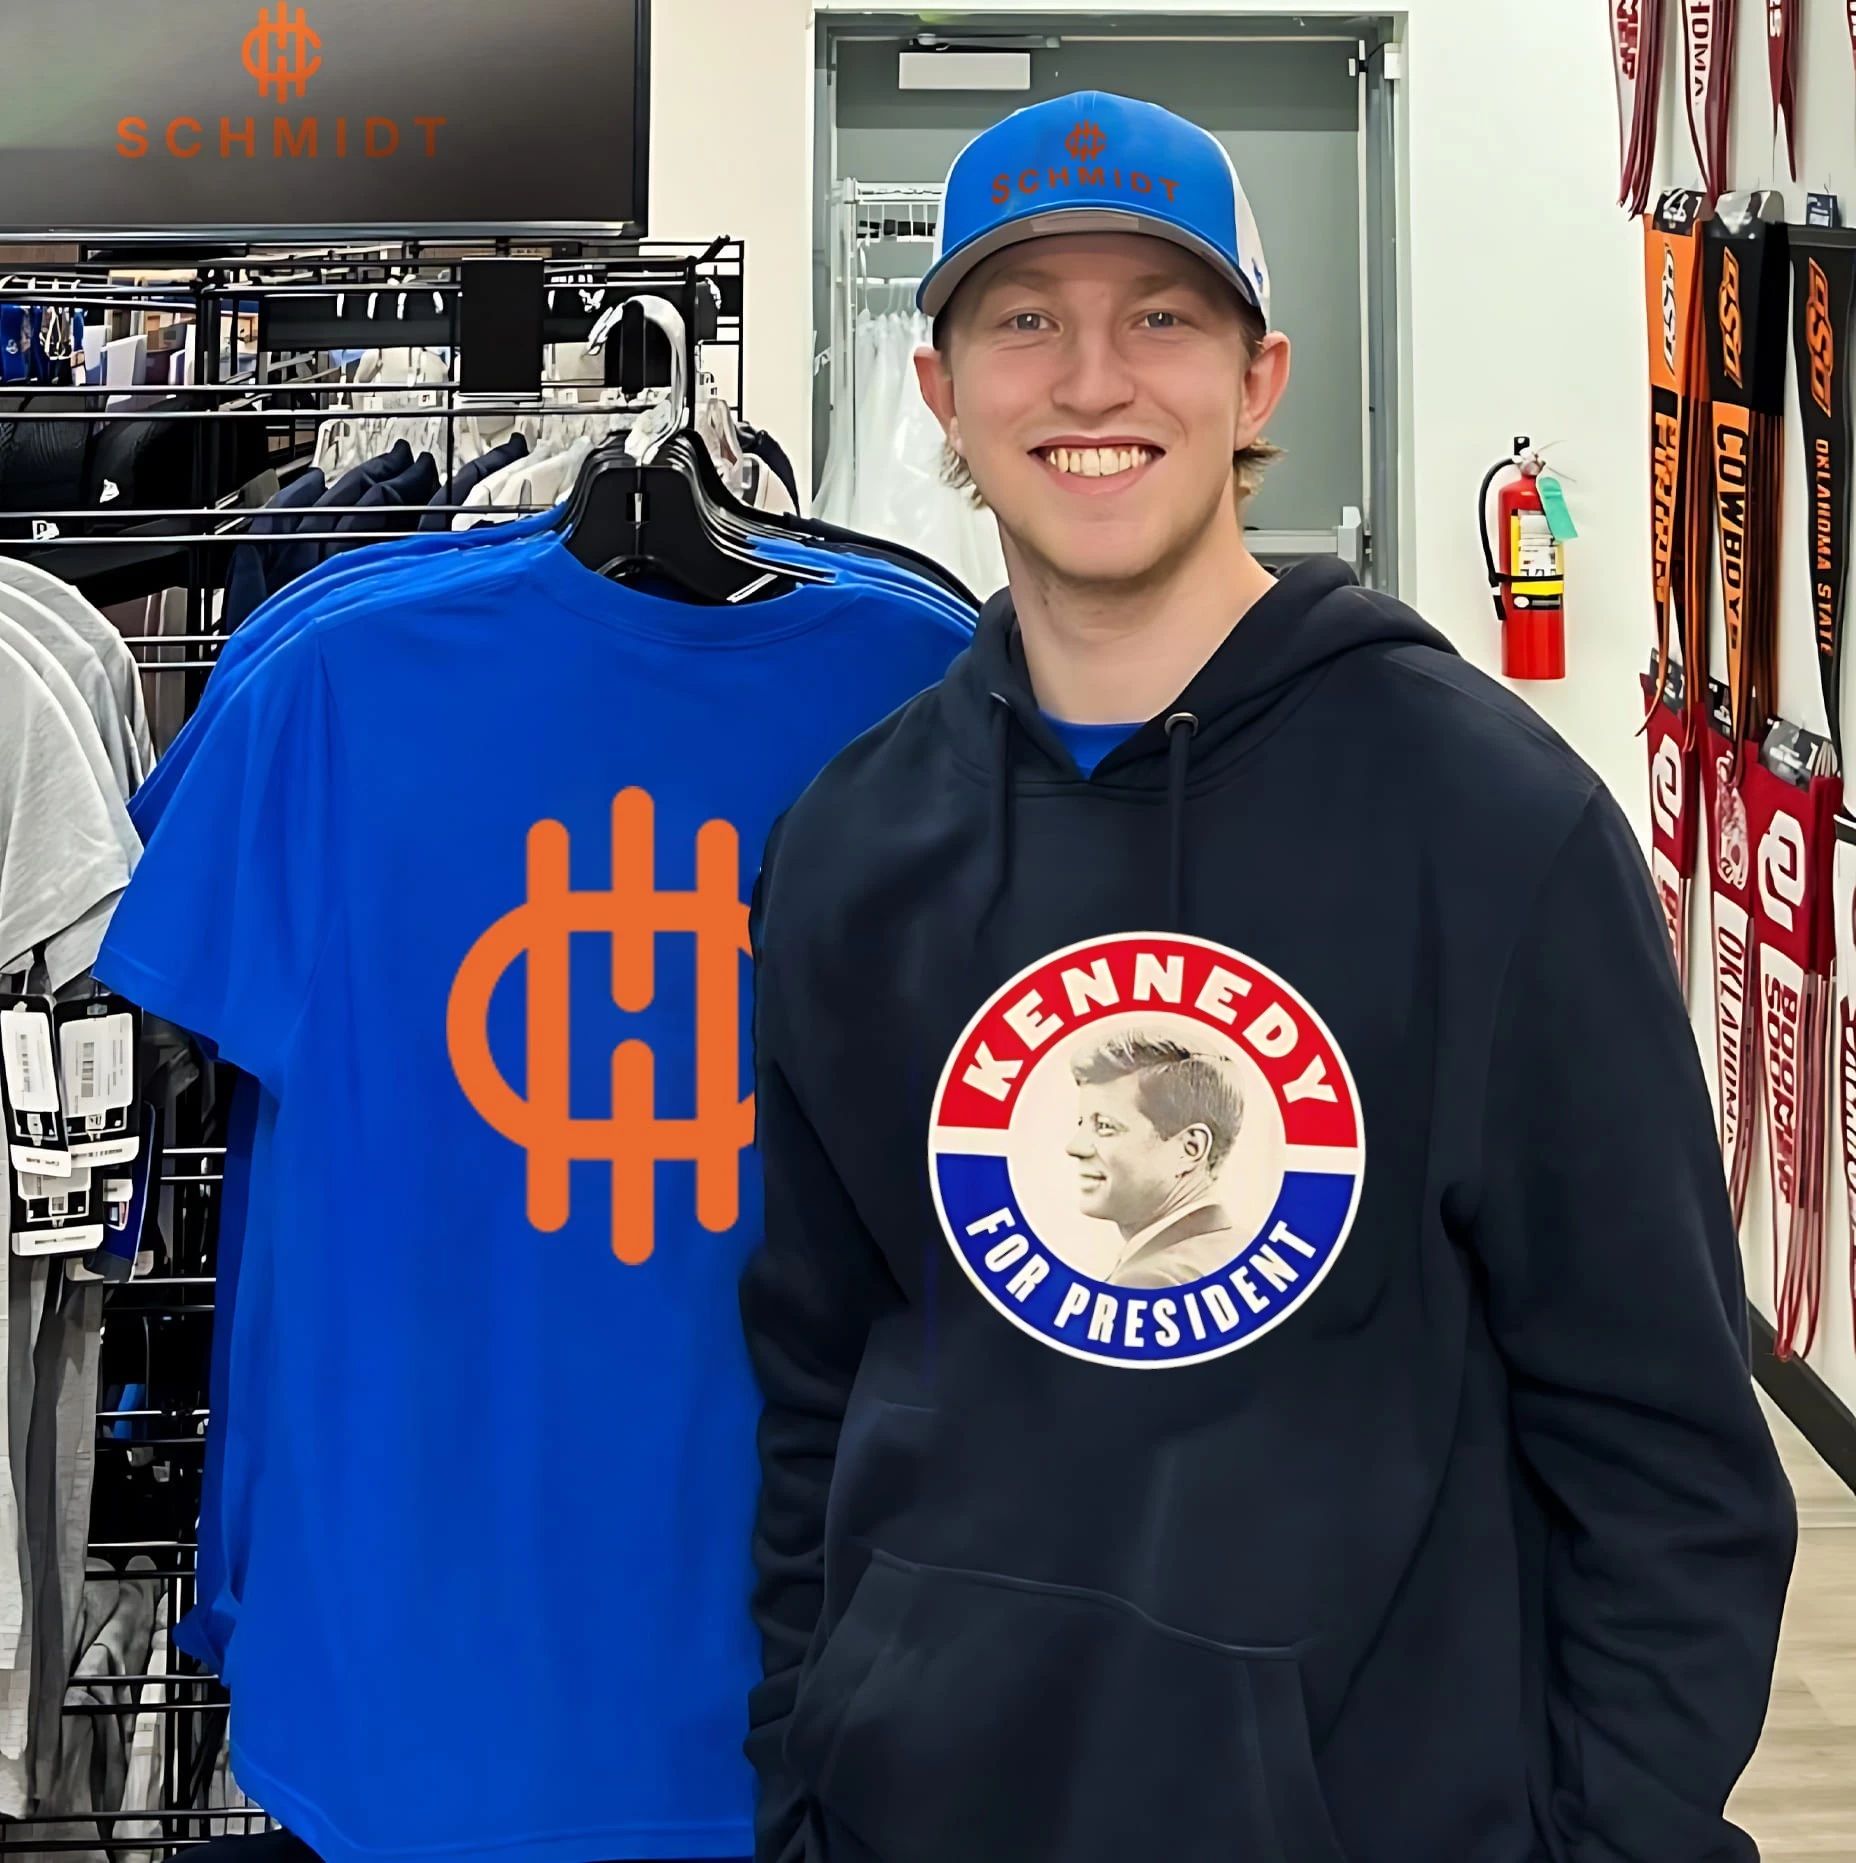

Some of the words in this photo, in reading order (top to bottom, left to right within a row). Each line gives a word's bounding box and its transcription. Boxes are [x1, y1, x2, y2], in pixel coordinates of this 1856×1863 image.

[115, 115, 447, 159] SCHMIDT
[991, 166, 1181, 205] SCHMIDT
[1716, 423, 1749, 650] COWBOY
[1815, 438, 1832, 570] OKLAHOMA
[961, 952, 1339, 1104] KENNEDY
[965, 1206, 1051, 1303] FOR
[1053, 1219, 1317, 1349] PRESIDENT
